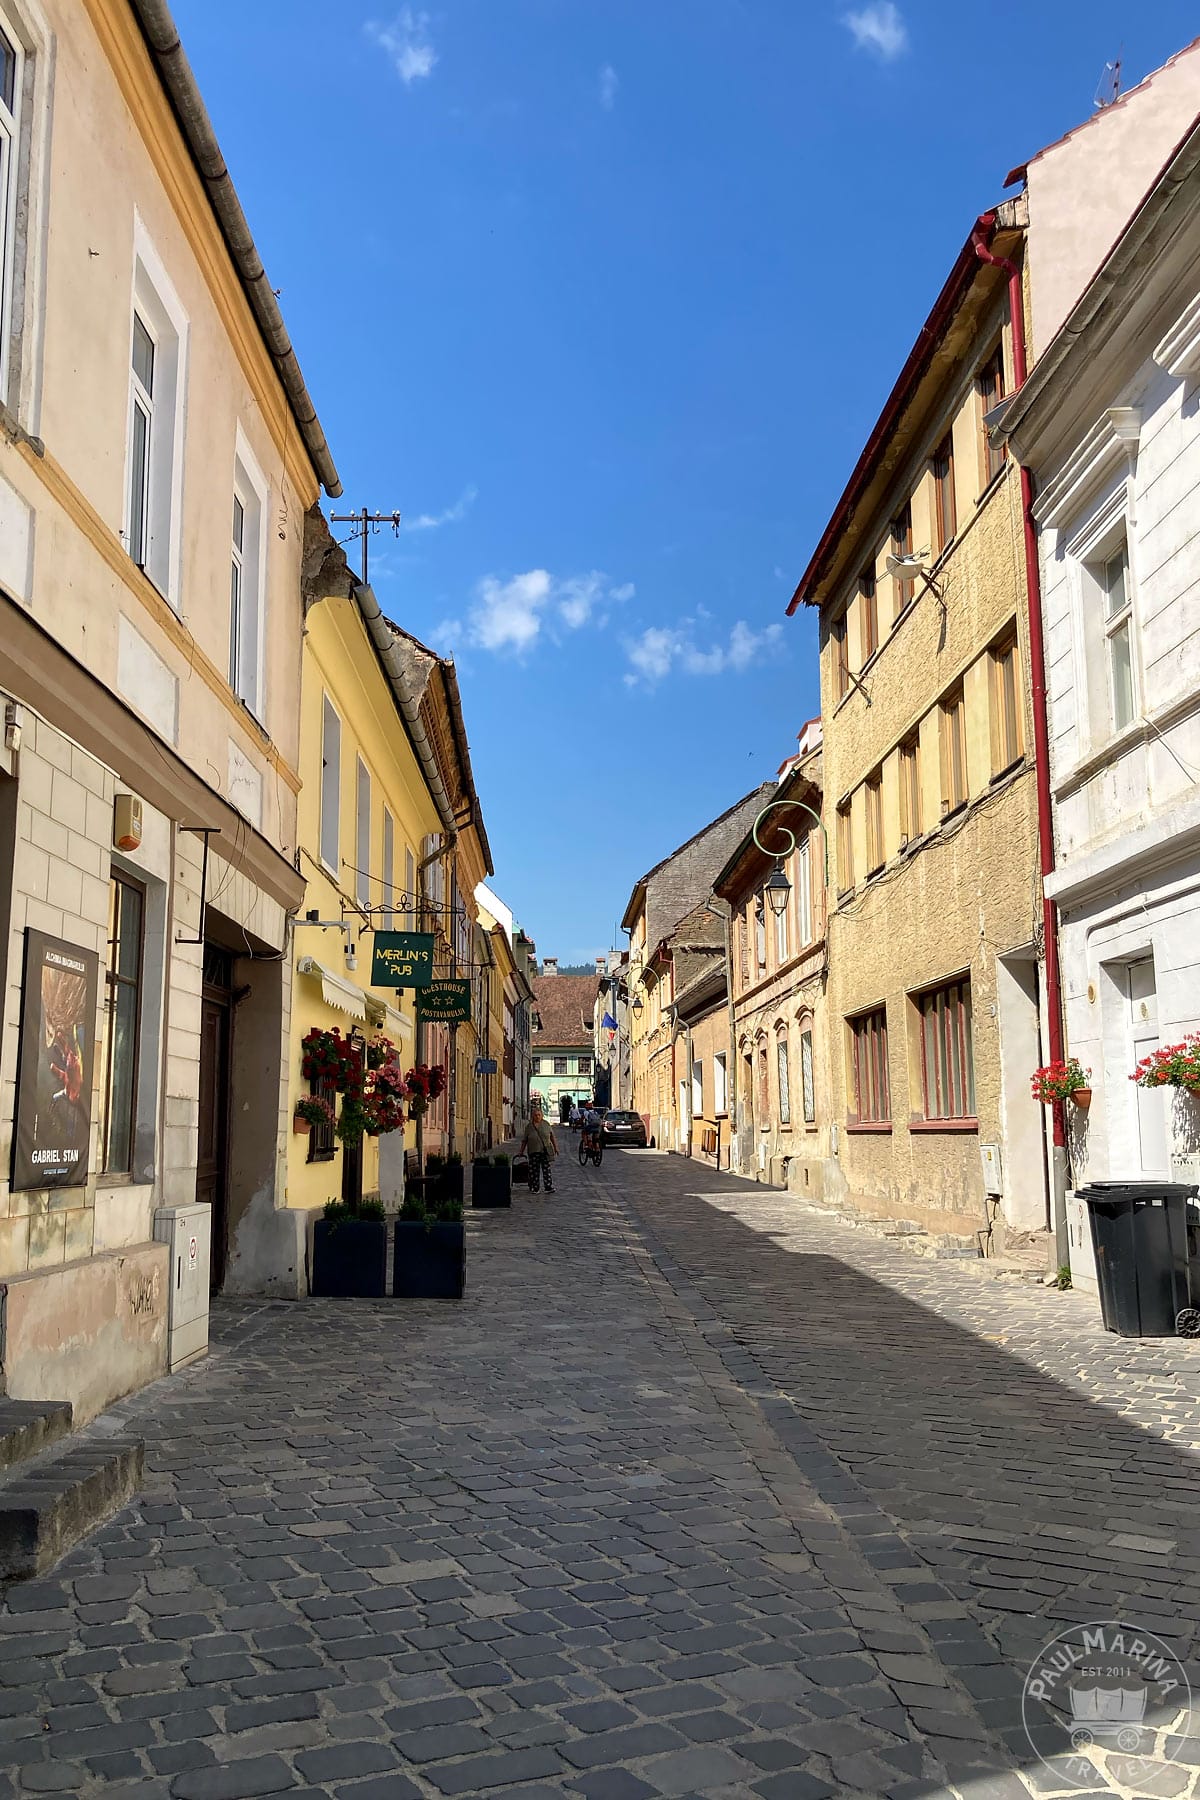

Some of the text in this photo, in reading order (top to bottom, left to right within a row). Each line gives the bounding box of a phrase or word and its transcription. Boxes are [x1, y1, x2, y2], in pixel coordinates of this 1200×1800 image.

[376, 948, 429, 962] MERLIN'S
[390, 964, 413, 976] PUB
[421, 982, 467, 996] GUESTHOUSE
[31, 1148, 79, 1164] GABRIEL STAN
